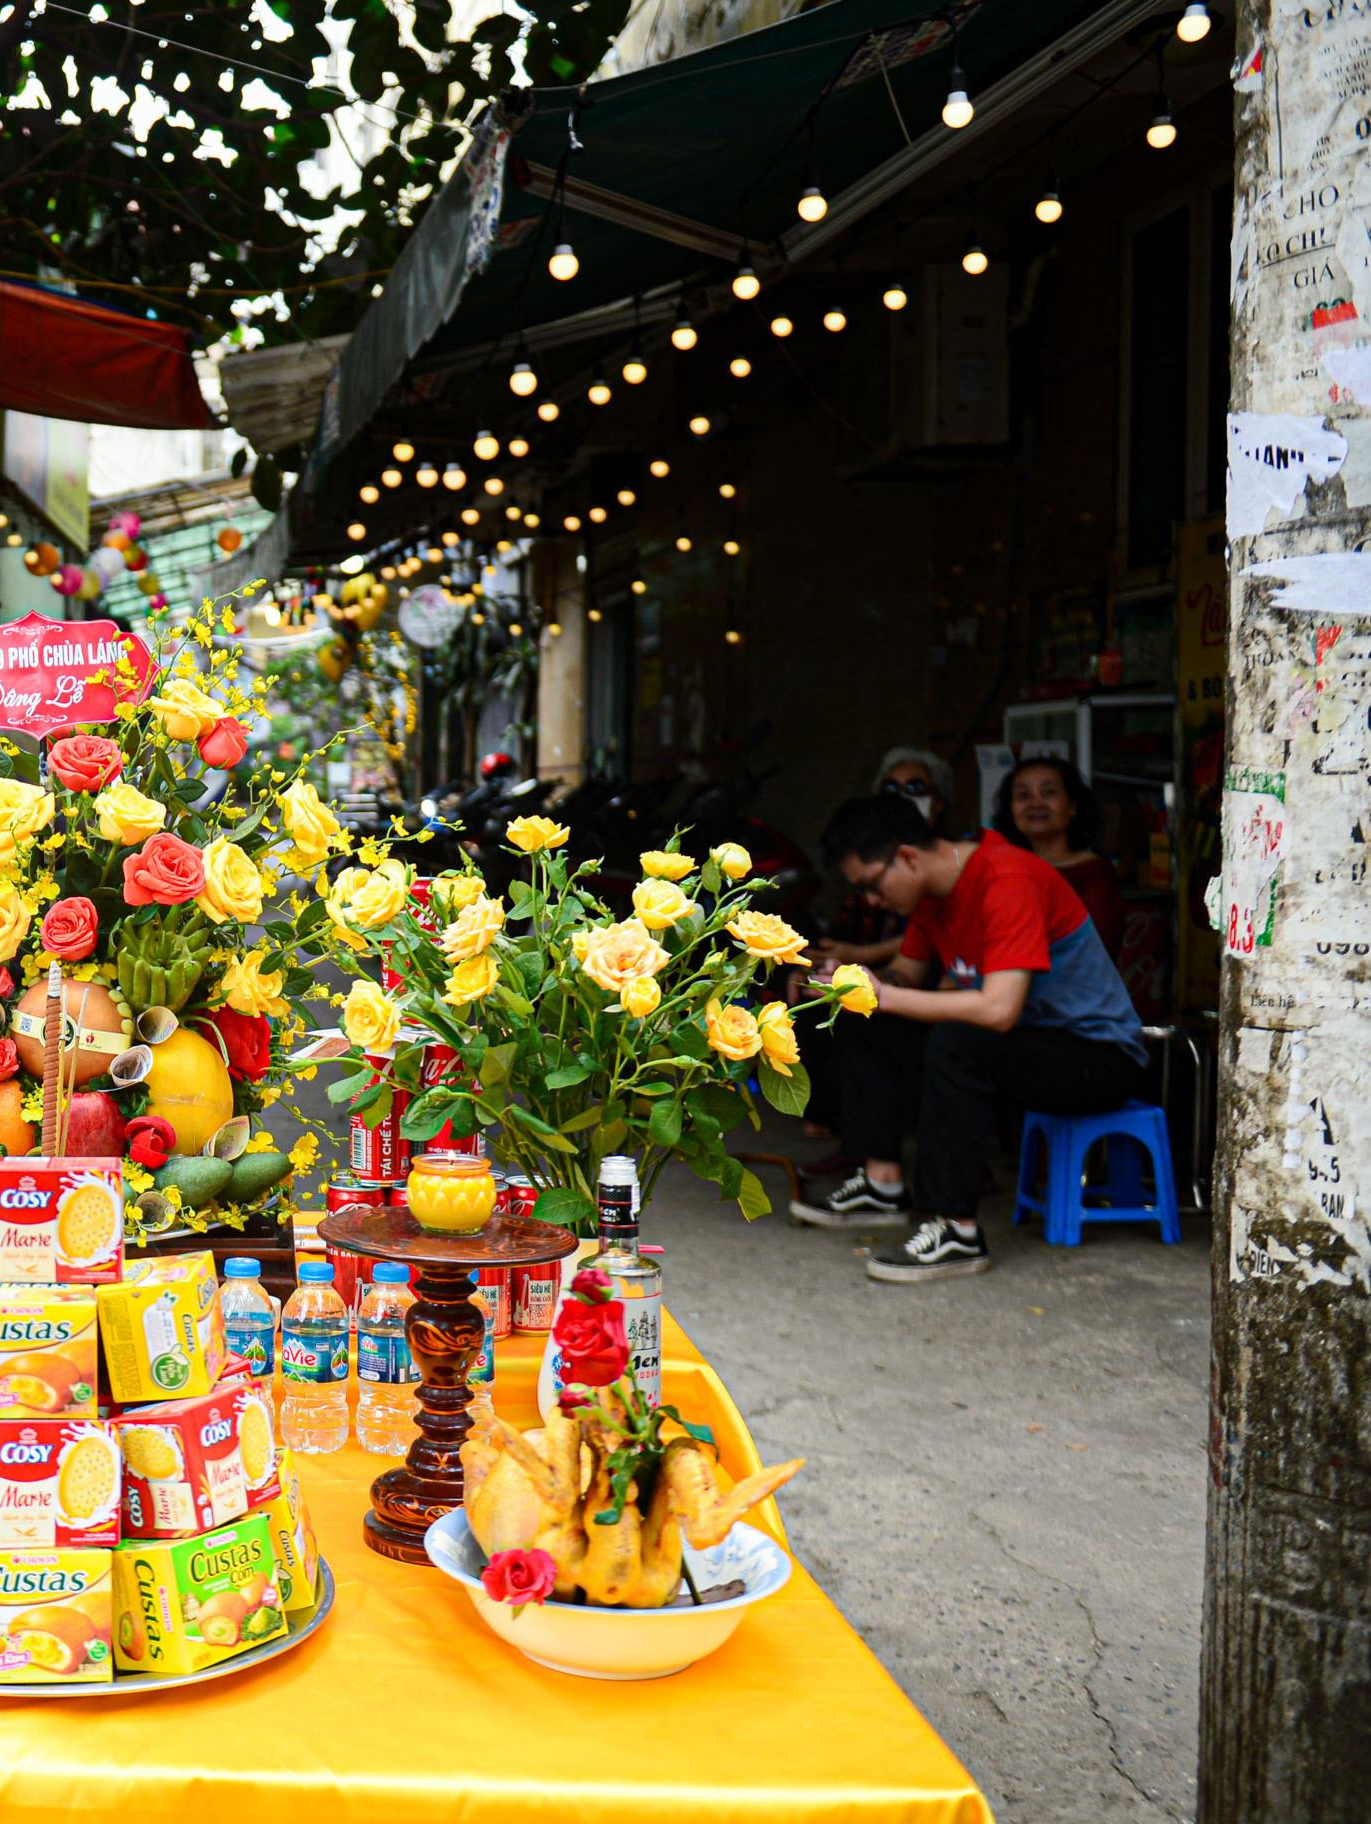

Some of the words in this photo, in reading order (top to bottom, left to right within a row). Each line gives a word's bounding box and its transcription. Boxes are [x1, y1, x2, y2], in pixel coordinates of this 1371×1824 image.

[1293, 256, 1335, 289] GIÁ
[8, 639, 40, 669] PHỐ
[43, 641, 84, 668] CHÙA
[46, 675, 87, 706] Lễ
[0, 1188, 53, 1209] COSY
[0, 1227, 52, 1249] Marie
[199, 1418, 233, 1449] COSY
[0, 1442, 55, 1464] COSY
[210, 1461, 241, 1486] Marie
[0, 1485, 52, 1509] Marie
[128, 1484, 144, 1529] COSY
[158, 1487, 173, 1525] Marie
[190, 1539, 262, 1583] Custas
[278, 1529, 295, 1568] Custas
[134, 1558, 165, 1662] Custas
